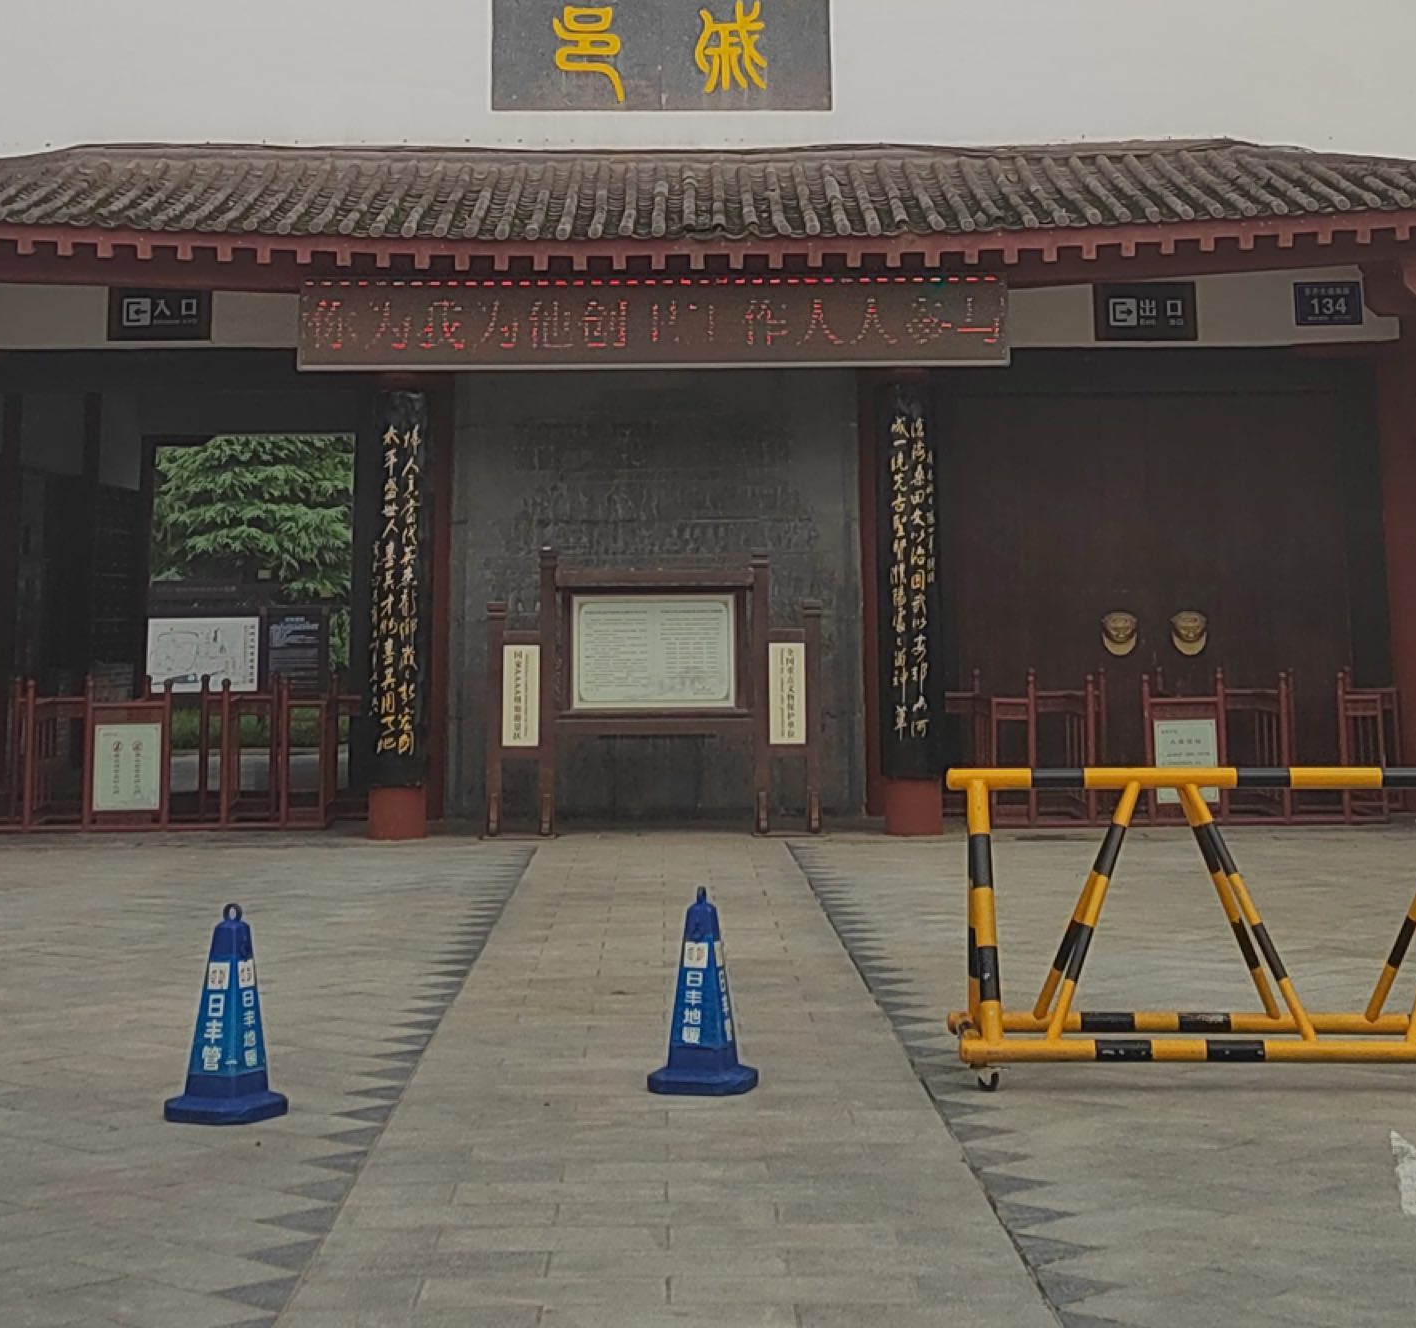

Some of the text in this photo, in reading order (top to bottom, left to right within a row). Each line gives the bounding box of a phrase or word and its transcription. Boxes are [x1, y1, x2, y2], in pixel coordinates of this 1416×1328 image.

[152, 298, 197, 317] 入口
[1139, 297, 1183, 316] 出口
[1310, 297, 1347, 315] 134
[201, 993, 227, 1072] 日丰管
